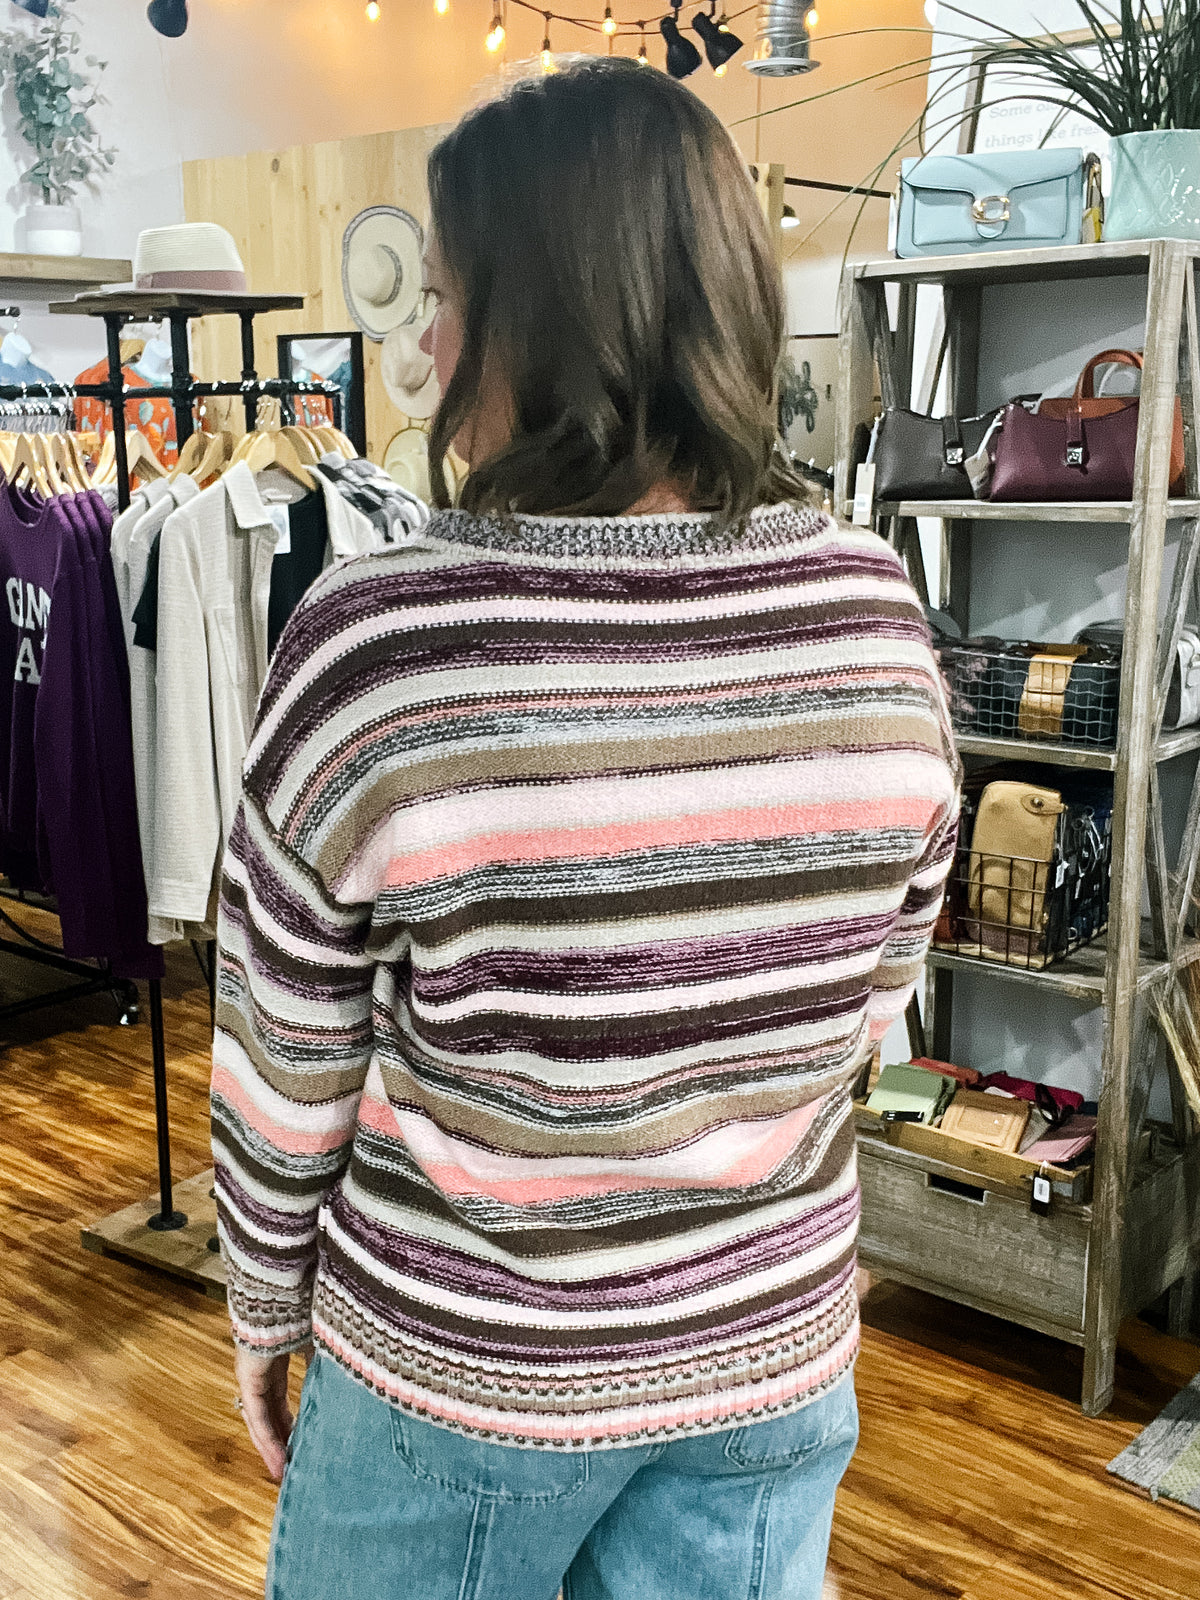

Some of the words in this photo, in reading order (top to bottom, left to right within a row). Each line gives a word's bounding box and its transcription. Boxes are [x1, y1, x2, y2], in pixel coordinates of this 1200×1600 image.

[989, 105, 1033, 119] Some
[985, 133, 1033, 149] things
[1038, 128, 1067, 141] lke
